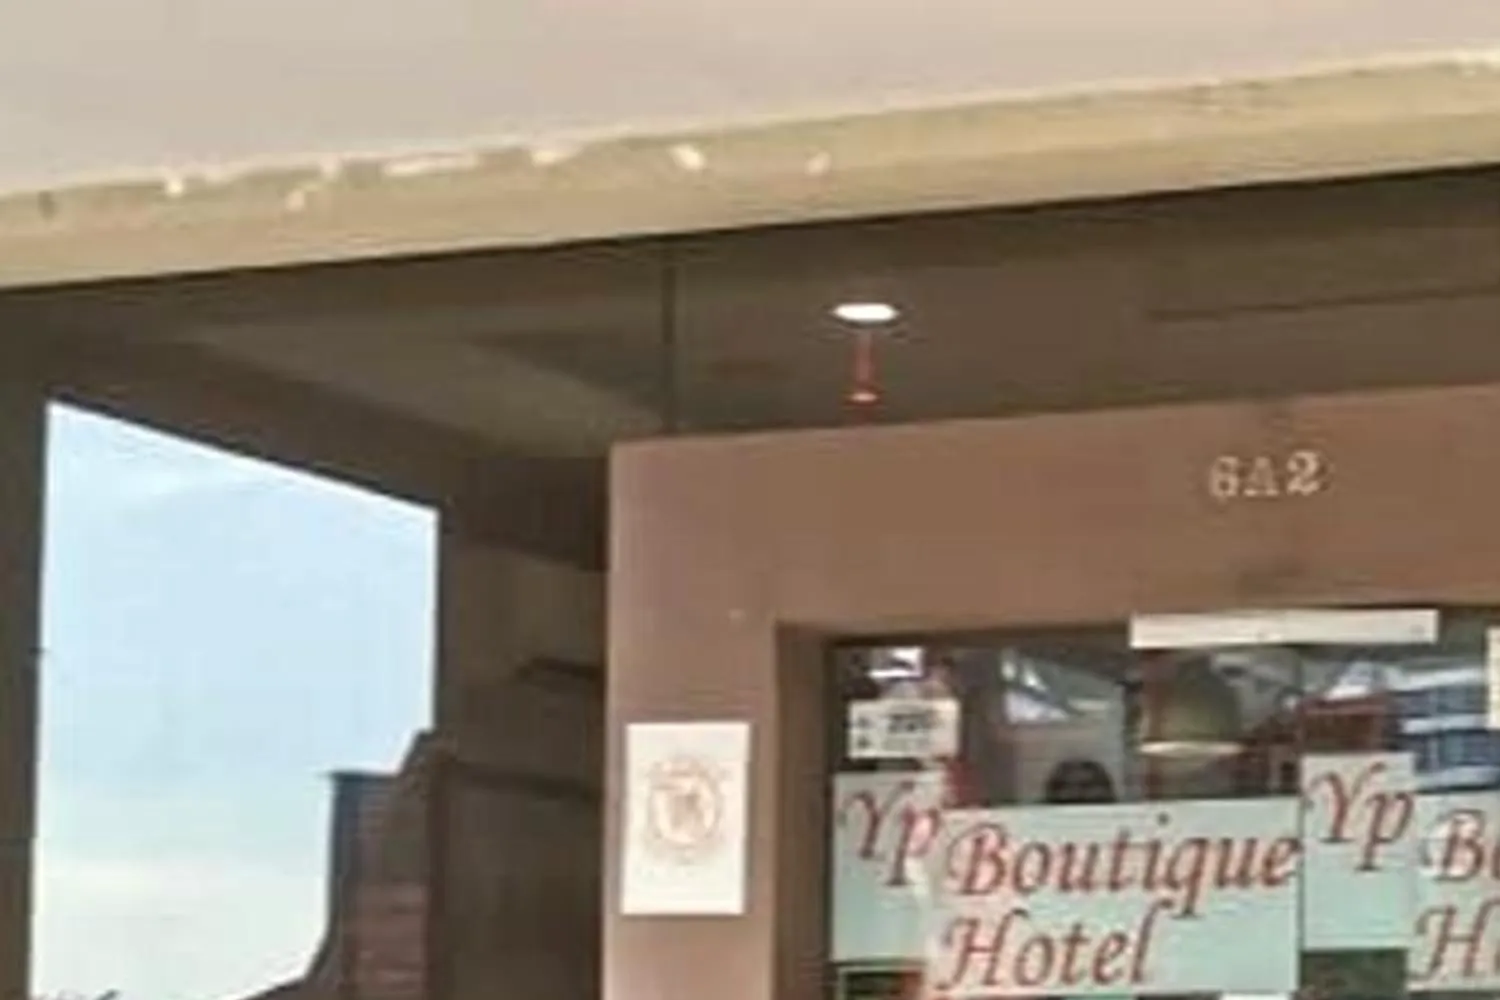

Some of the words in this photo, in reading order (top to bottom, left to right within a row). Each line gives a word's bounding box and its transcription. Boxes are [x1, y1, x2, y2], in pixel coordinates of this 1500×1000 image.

[1209, 451, 1320, 497] 6A2
[838, 780, 941, 887] Yp
[945, 811, 1299, 920] Boutique
[1310, 763, 1415, 873] Yp
[935, 901, 1174, 989] Hotel
